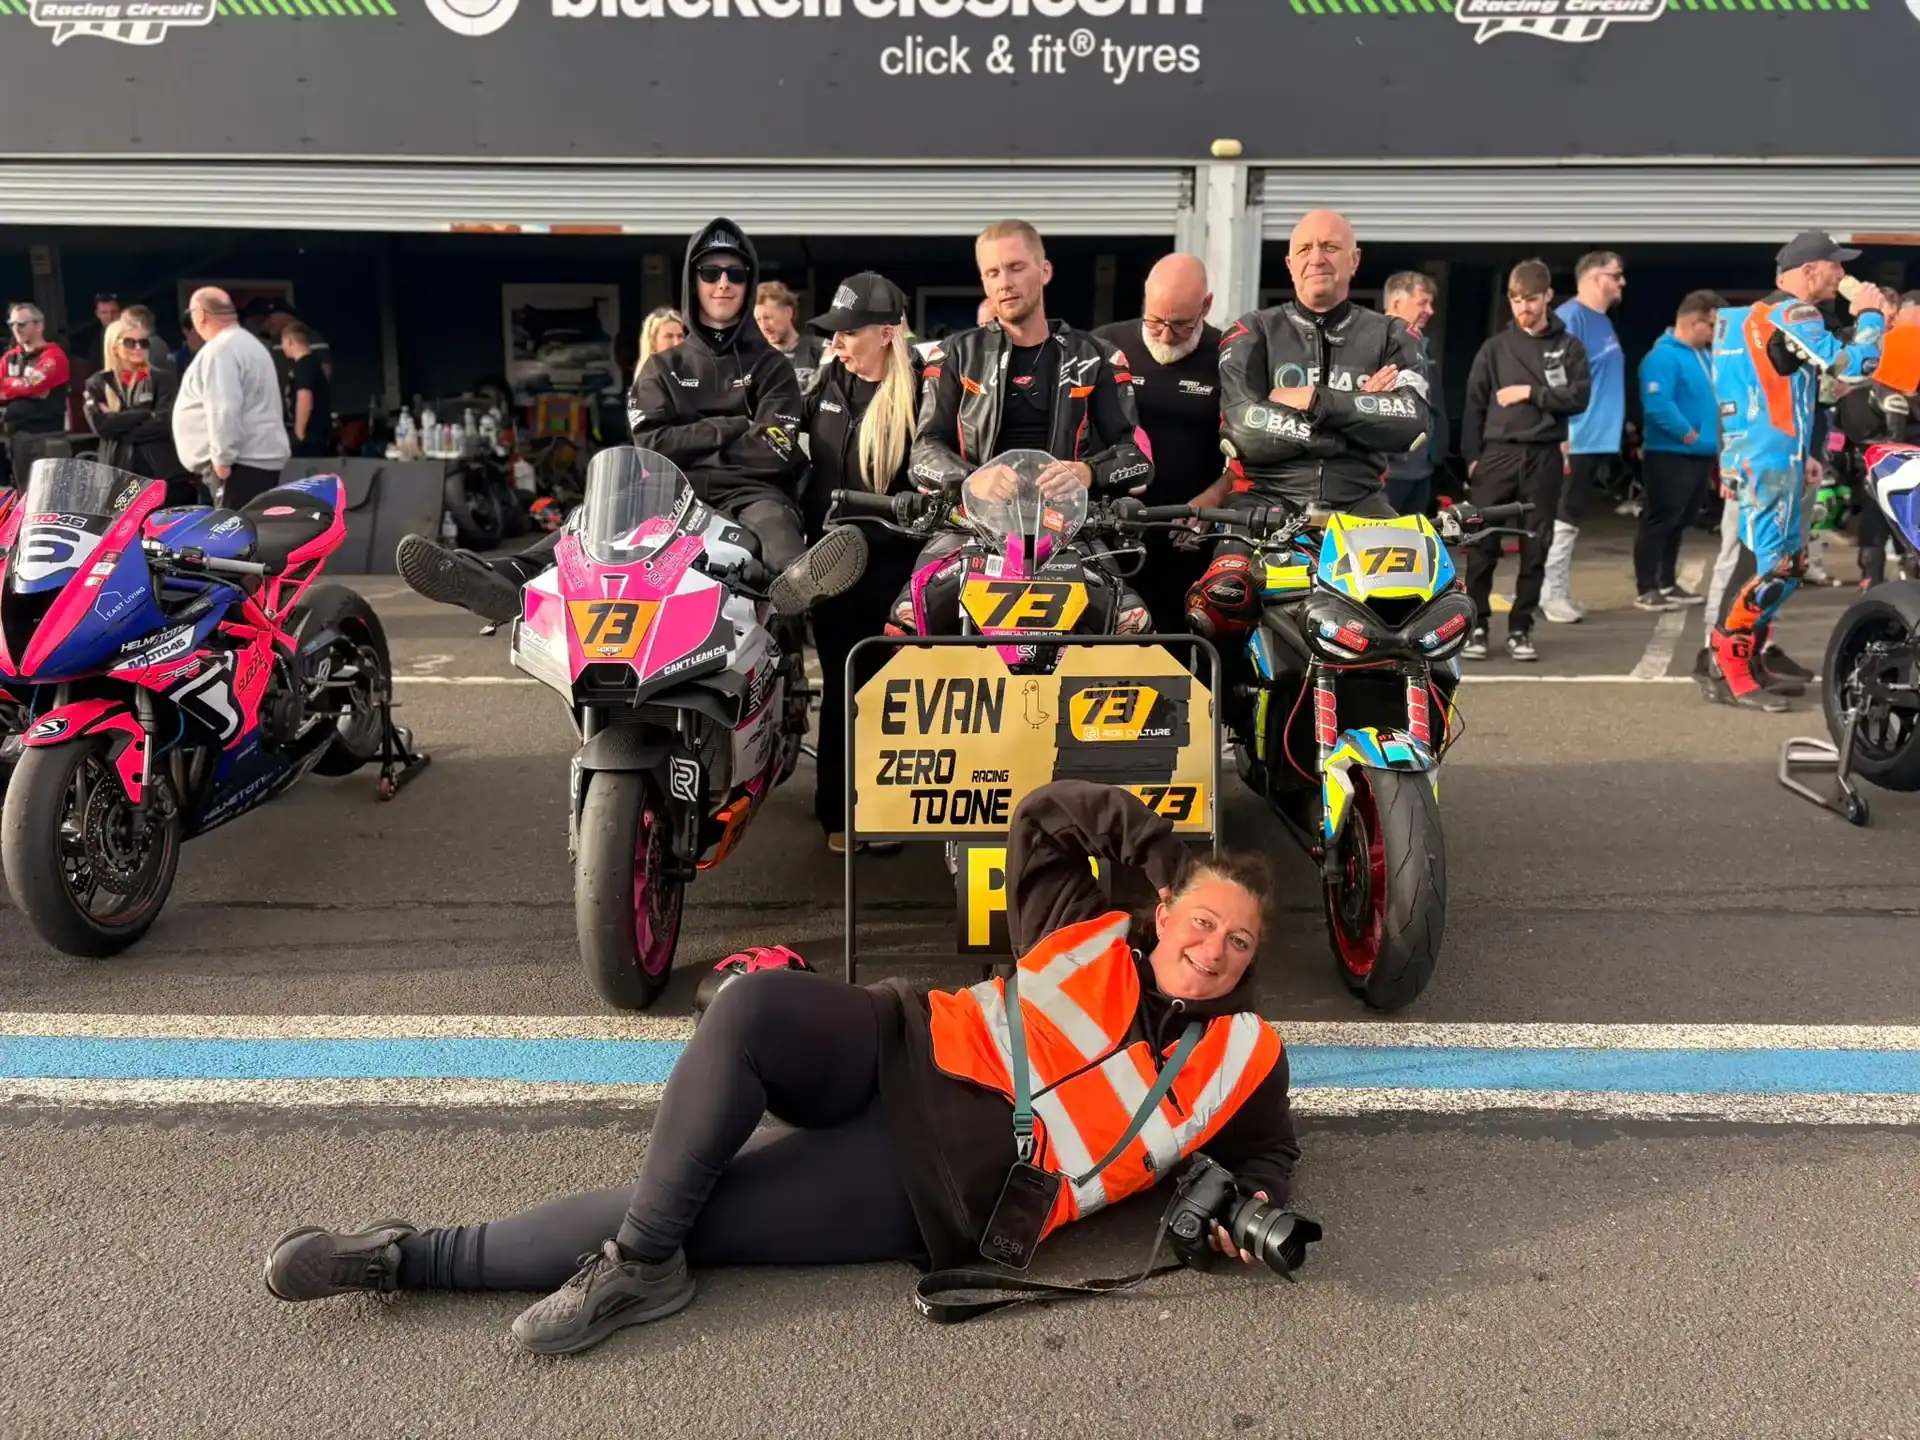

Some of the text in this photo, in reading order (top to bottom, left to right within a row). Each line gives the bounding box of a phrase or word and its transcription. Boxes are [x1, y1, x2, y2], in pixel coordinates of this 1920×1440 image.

[41, 2, 205, 18] Racing Circuit
[880, 35, 972, 75] click
[985, 34, 1015, 75] &
[1100, 37, 1201, 84] tyres
[1378, 397, 1418, 415] BAS
[1266, 412, 1312, 438] BAS
[1363, 546, 1418, 576] 73
[982, 582, 1073, 629] 73
[583, 603, 640, 645] 73
[690, 649, 714, 665] LEAN
[881, 677, 1007, 736] EVAN
[1081, 688, 1140, 725] 73
[876, 748, 957, 786] ZERO
[971, 769, 1010, 784] RACING
[909, 788, 1013, 825] TO ONE
[1139, 786, 1198, 822] 73
